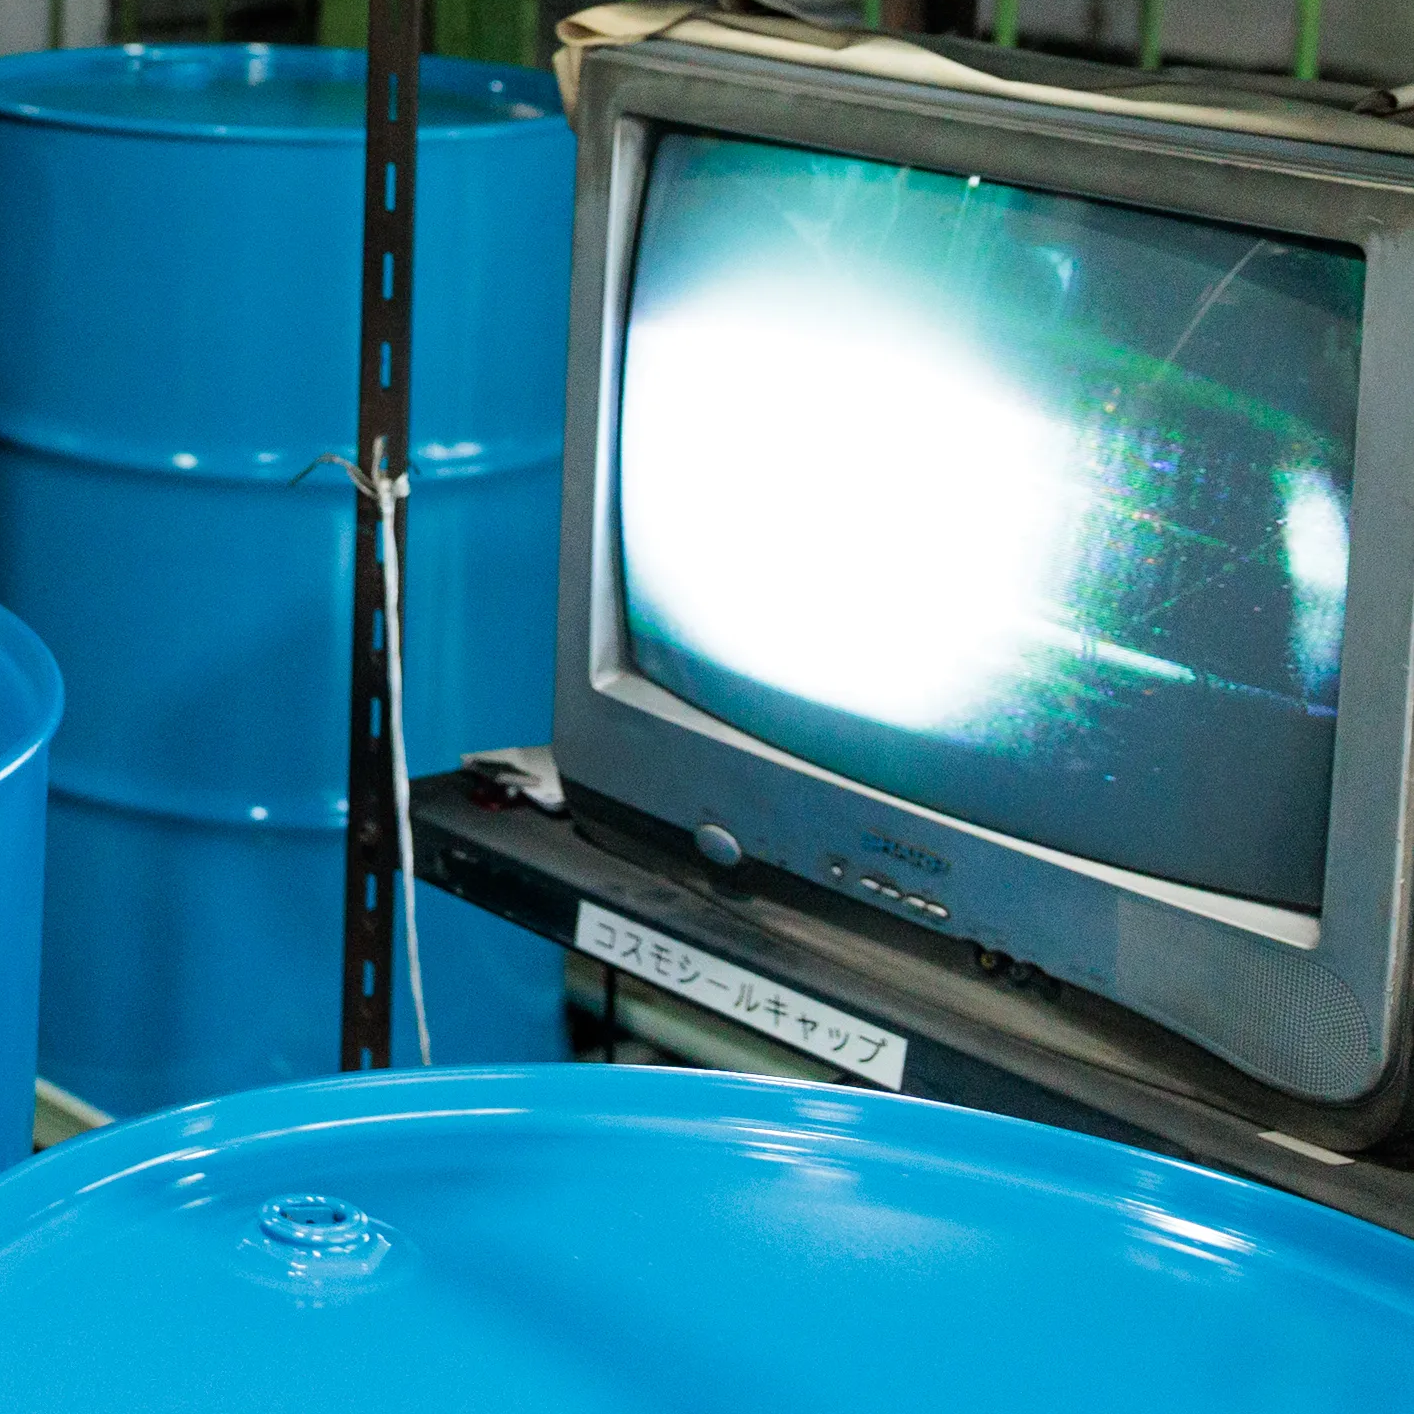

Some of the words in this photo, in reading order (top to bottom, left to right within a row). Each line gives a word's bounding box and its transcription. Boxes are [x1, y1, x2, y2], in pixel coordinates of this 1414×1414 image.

[595, 922, 888, 1063] コスモシールキャップ
